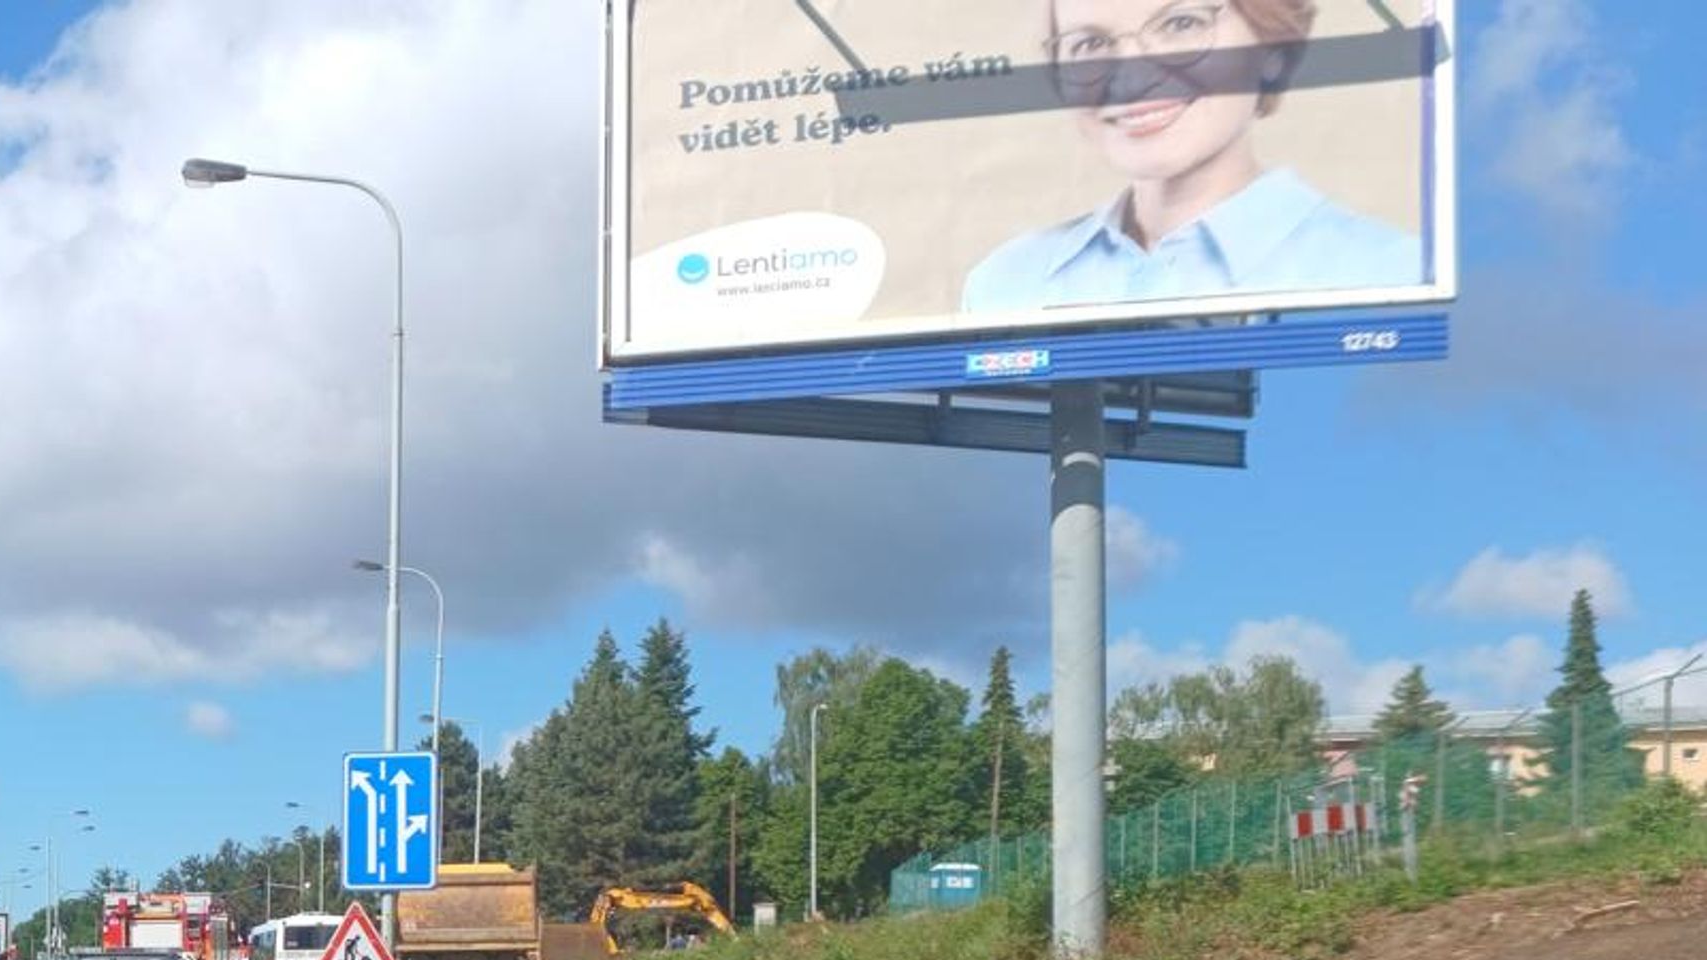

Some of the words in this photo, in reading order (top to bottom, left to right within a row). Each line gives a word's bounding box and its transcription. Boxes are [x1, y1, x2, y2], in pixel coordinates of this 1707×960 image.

[679, 64, 910, 109] Pomůžeme
[923, 52, 1014, 83] vám
[678, 117, 781, 153] vidět
[794, 110, 892, 145] lépe.
[716, 247, 859, 277] Lentiamo
